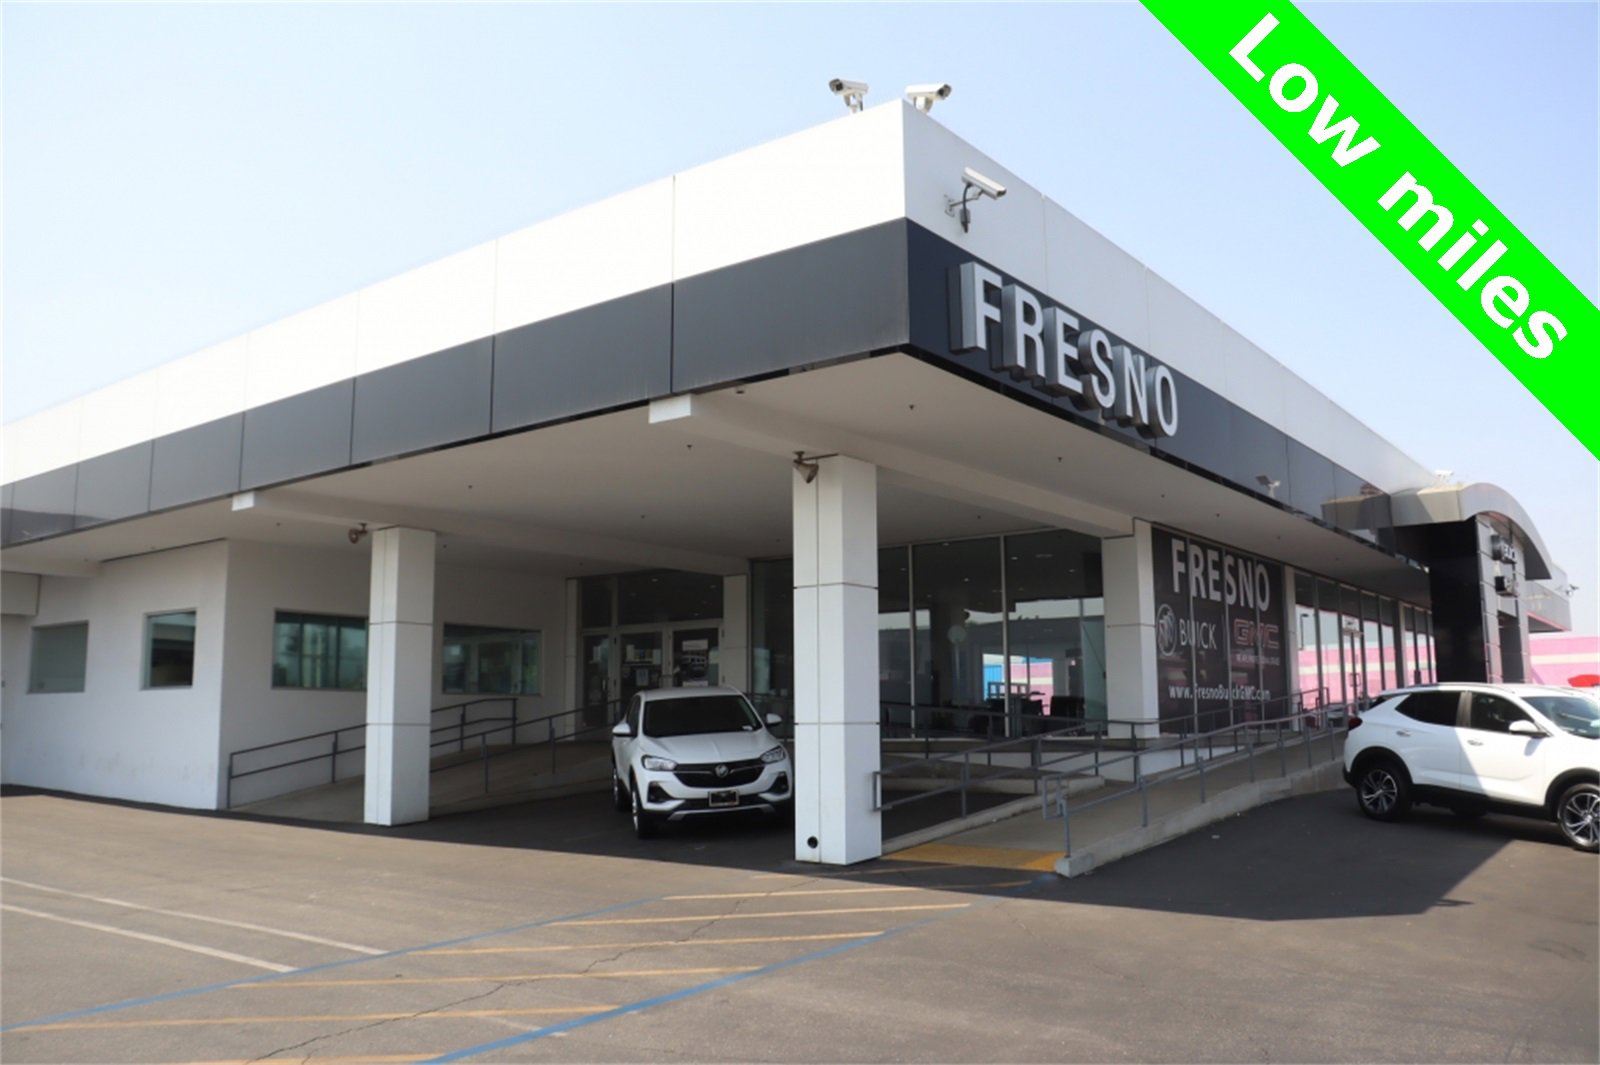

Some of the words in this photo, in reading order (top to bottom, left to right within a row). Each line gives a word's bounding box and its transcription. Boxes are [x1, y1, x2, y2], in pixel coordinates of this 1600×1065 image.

[961, 261, 1178, 437] FRESNO
[1171, 538, 1270, 612] FRESNO
[1179, 619, 1217, 650] BUICK
[1233, 618, 1279, 649] GMC
[1168, 684, 1271, 700] www.FresnoBuckGMC.com
